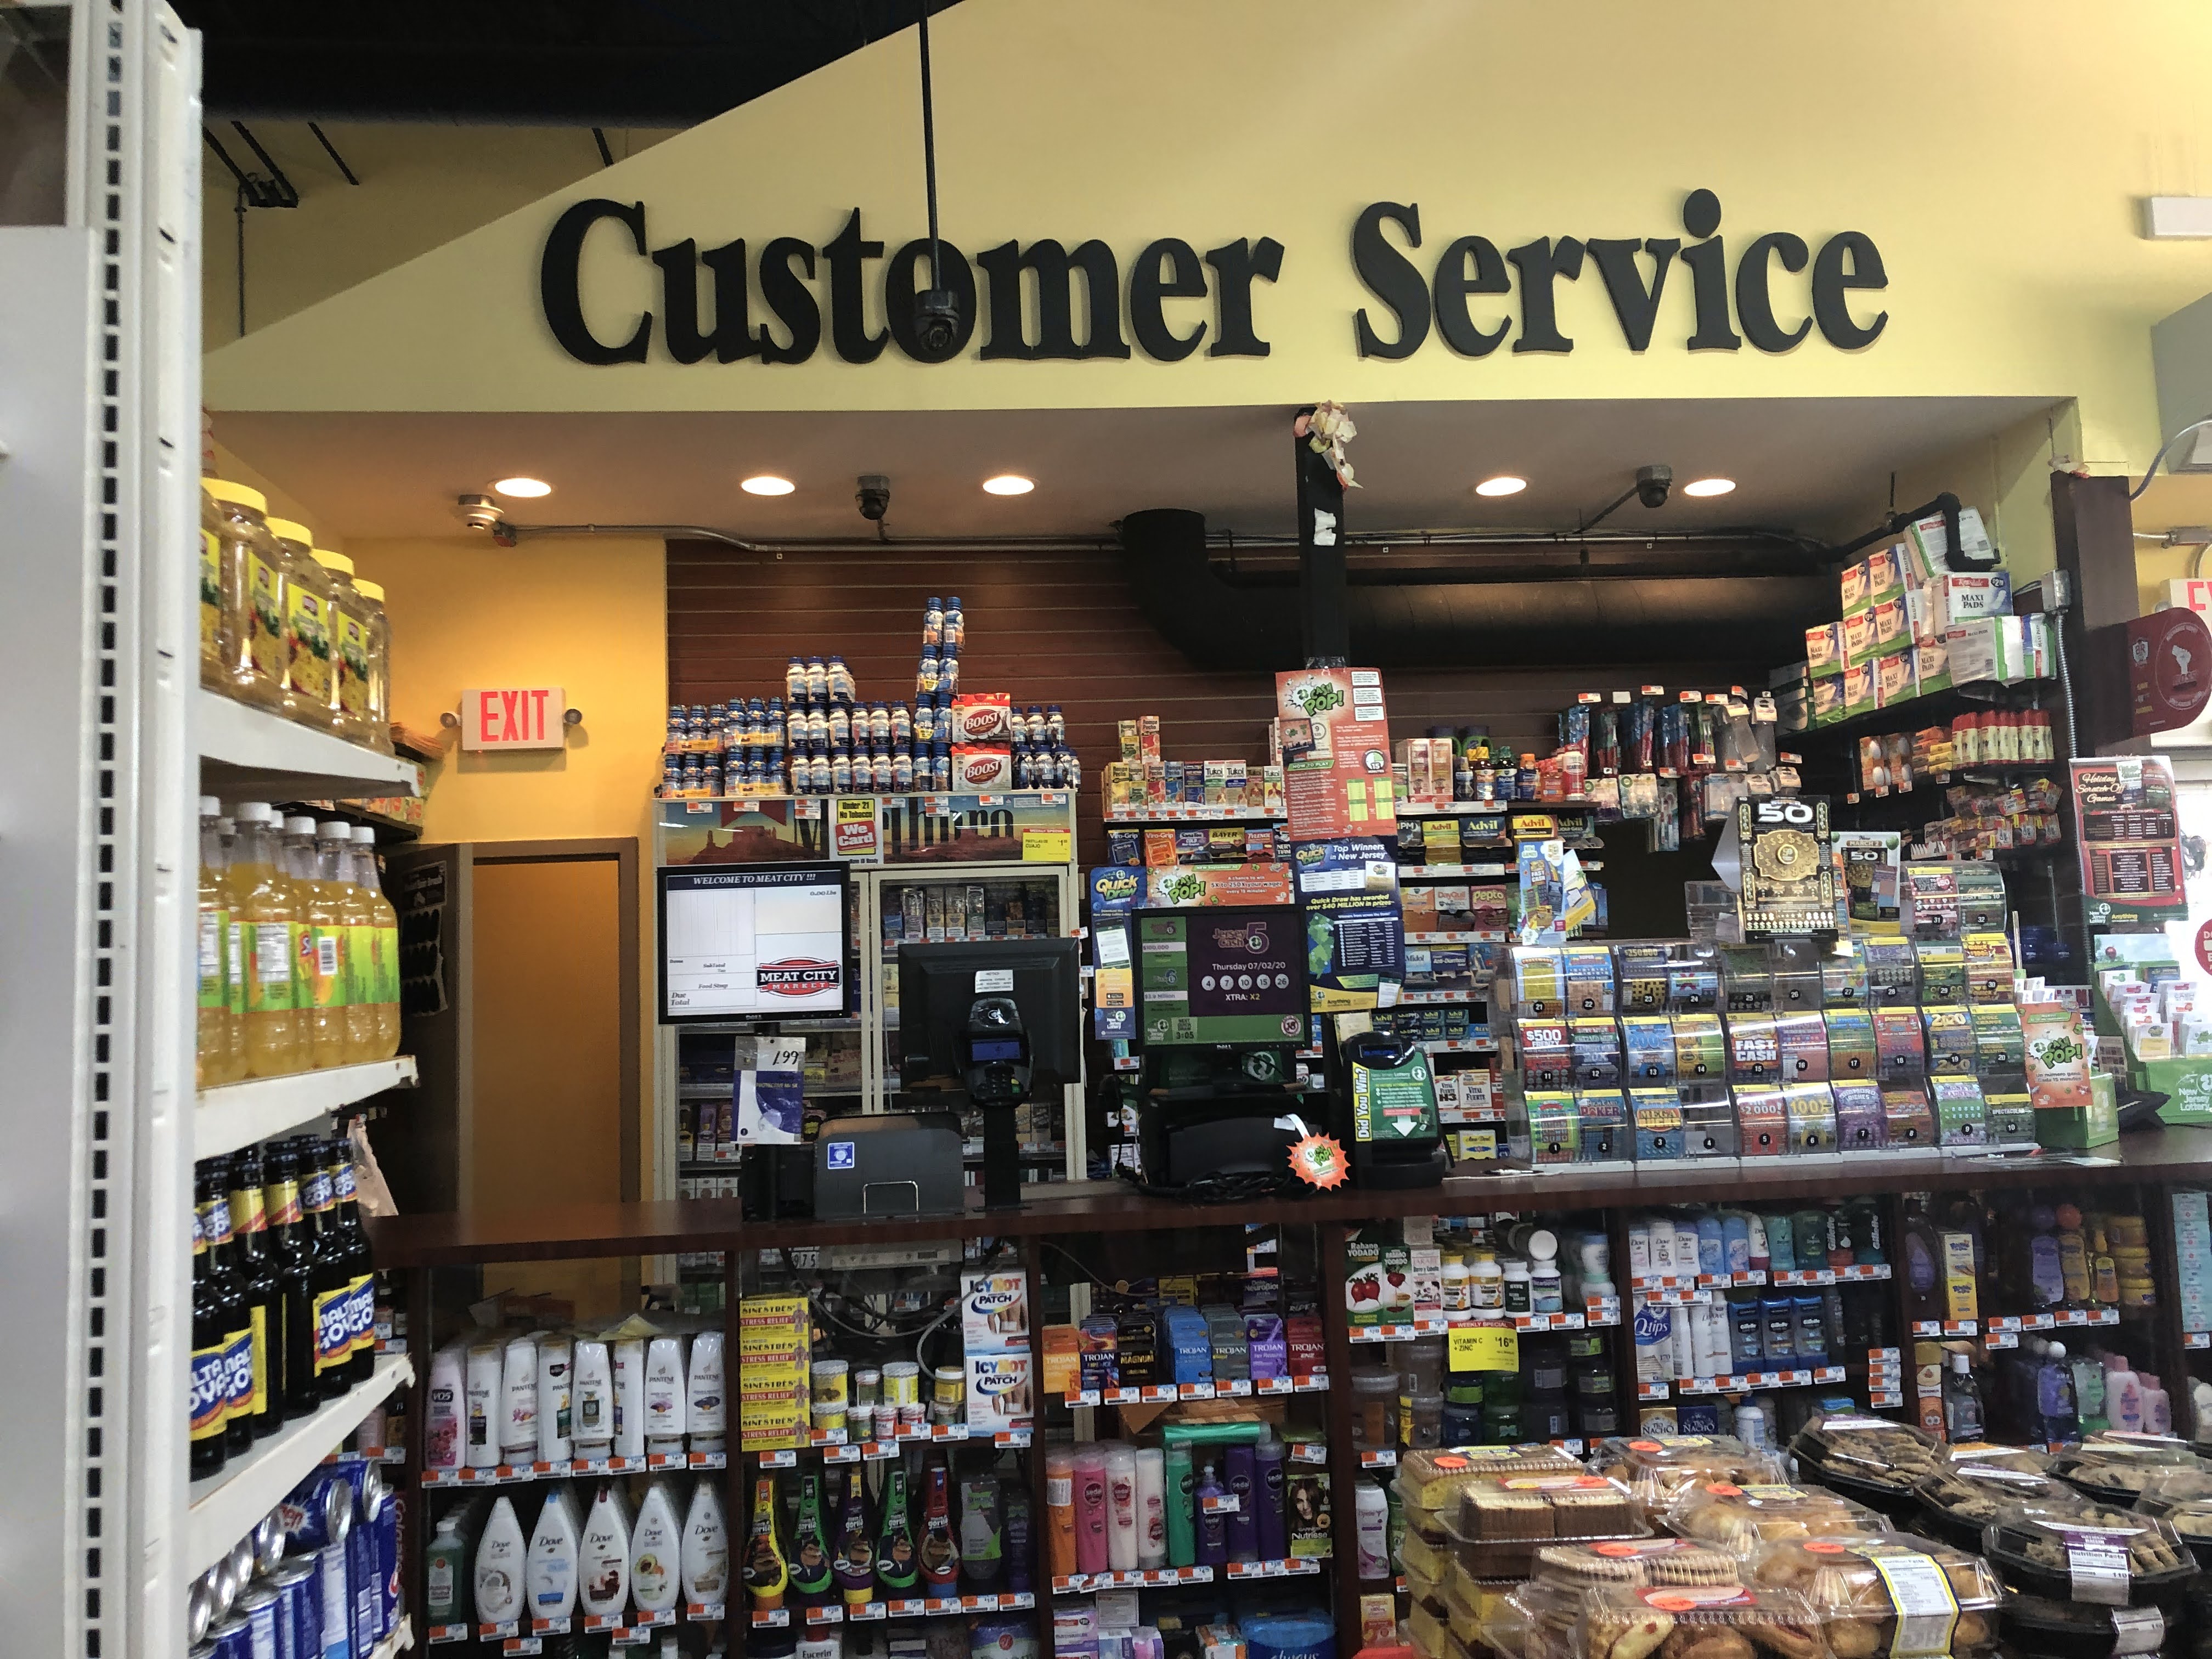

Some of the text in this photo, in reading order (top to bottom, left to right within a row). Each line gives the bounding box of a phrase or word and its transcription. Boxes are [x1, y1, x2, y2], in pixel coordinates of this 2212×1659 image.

[540, 188, 1889, 366] Customer Service
[1304, 690, 1344, 716] POP!
[480, 690, 549, 742] EXIT
[966, 712, 1001, 730] BOOST
[967, 761, 1002, 778] BOOST
[2082, 774, 2117, 783] Holiday
[2075, 783, 2126, 794] Scratch-Off
[2087, 794, 2117, 804] Games
[1758, 803, 1813, 823] 50
[843, 824, 867, 835] We
[1467, 820, 1498, 830] Advil
[838, 834, 874, 846] Card
[1851, 852, 1878, 860] 50
[693, 877, 741, 885] WELCOME
[1096, 876, 1138, 893] Quick
[1168, 881, 1206, 904] POP!
[1473, 891, 1504, 902] pepto
[1213, 928, 1246, 941] Jersey
[1248, 962, 1286, 970] 07/02/20
[760, 970, 837, 982] MEAT CITY
[1931, 1014, 1966, 1026] 2020
[1526, 1029, 1561, 1041] $500
[1735, 1039, 1775, 1049] FAST
[1736, 1050, 1776, 1061] CASH
[2042, 1043, 2083, 1069] POP!
[1356, 1066, 1370, 1139] Did You Win?
[1439, 1093, 1457, 1102] H3
[1581, 1106, 1620, 1116] POKER
[979, 1294, 1012, 1305] PATCH
[1291, 1344, 1324, 1352] TROJAN
[1084, 1353, 1114, 1362] TROJAN
[1121, 1355, 1154, 1364] MAGNUM
[984, 1376, 1017, 1385] PATCH
[1643, 1425, 1674, 1435] NACHO
[1683, 1423, 1715, 1432] NACHO
[695, 1525, 718, 1535] Dove
[539, 1537, 563, 1546] Dove
[590, 1533, 613, 1543] Dove
[2071, 1550, 2101, 1559] Nutrition
[802, 1650, 832, 1659] Eucerin
